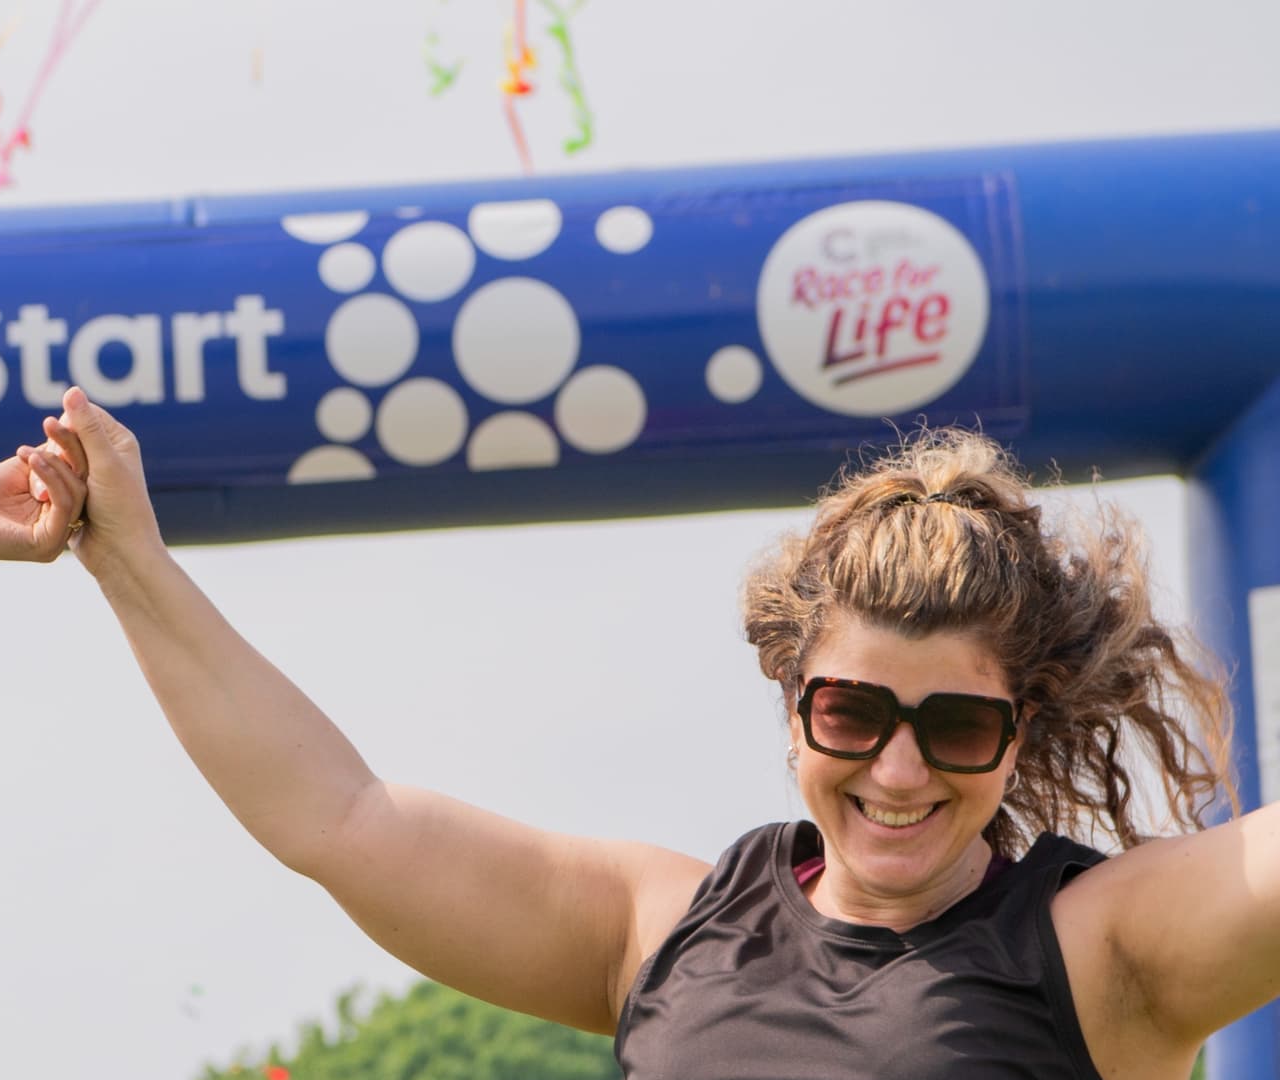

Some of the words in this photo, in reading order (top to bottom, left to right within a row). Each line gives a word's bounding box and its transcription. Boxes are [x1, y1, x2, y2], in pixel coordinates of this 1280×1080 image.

[792, 264, 882, 311] Race
[893, 258, 940, 288] for
[821, 294, 949, 370] Life
